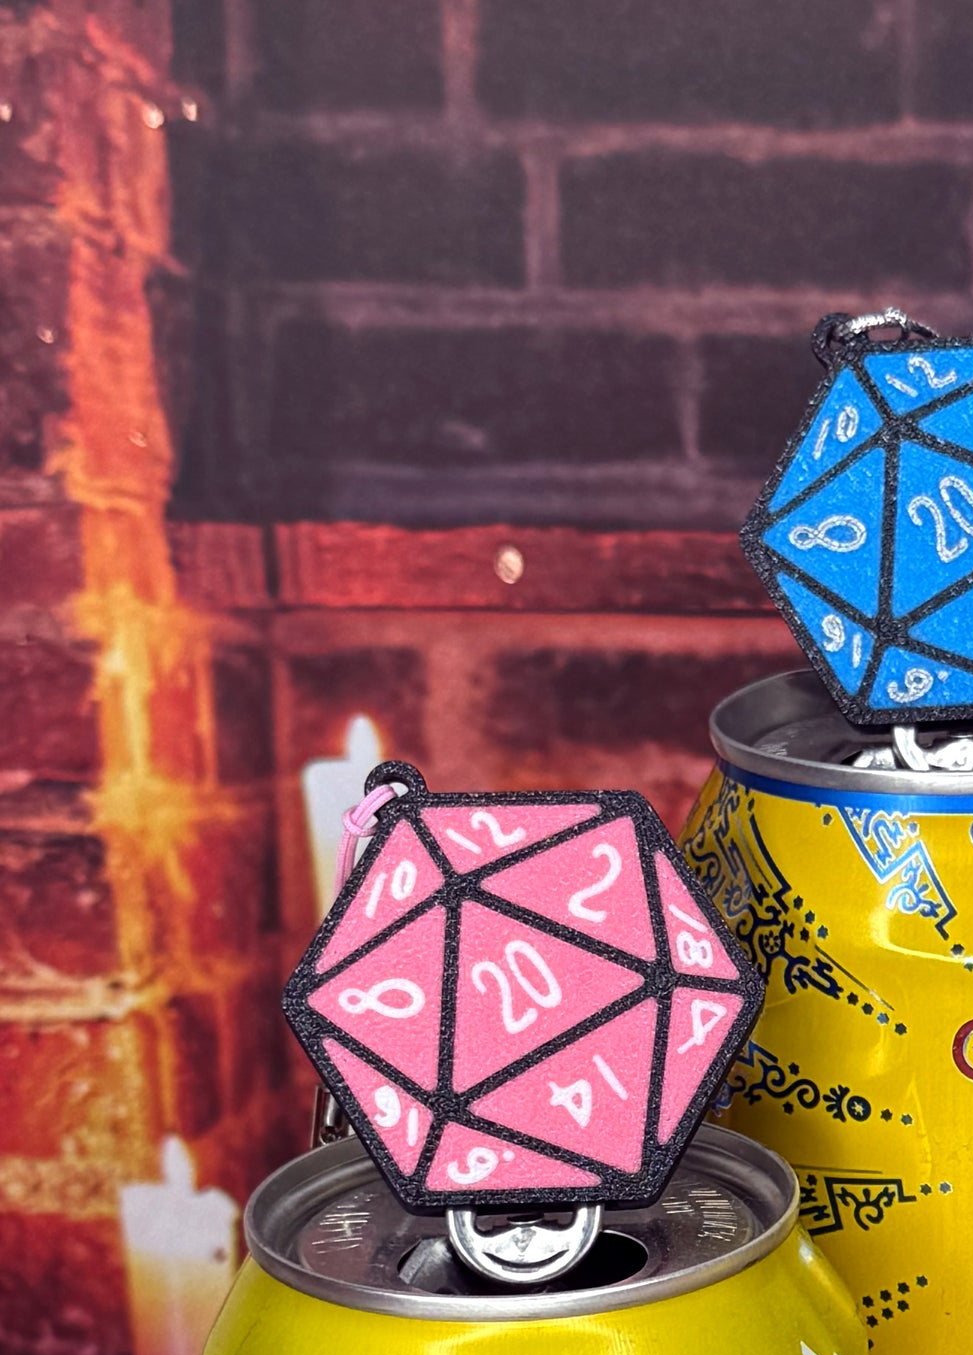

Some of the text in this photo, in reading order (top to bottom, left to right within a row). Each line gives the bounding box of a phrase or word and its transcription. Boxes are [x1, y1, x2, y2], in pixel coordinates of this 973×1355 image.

[885, 356, 957, 397] 12
[812, 405, 859, 460] 10
[787, 514, 868, 552] 8
[445, 810, 527, 855] 12
[365, 859, 418, 918] 10
[567, 842, 623, 923] 2
[667, 902, 712, 970] 18
[337, 977, 426, 1019] 8
[470, 938, 564, 1035] 20
[676, 998, 729, 1056] 4
[549, 1053, 629, 1129] 14
